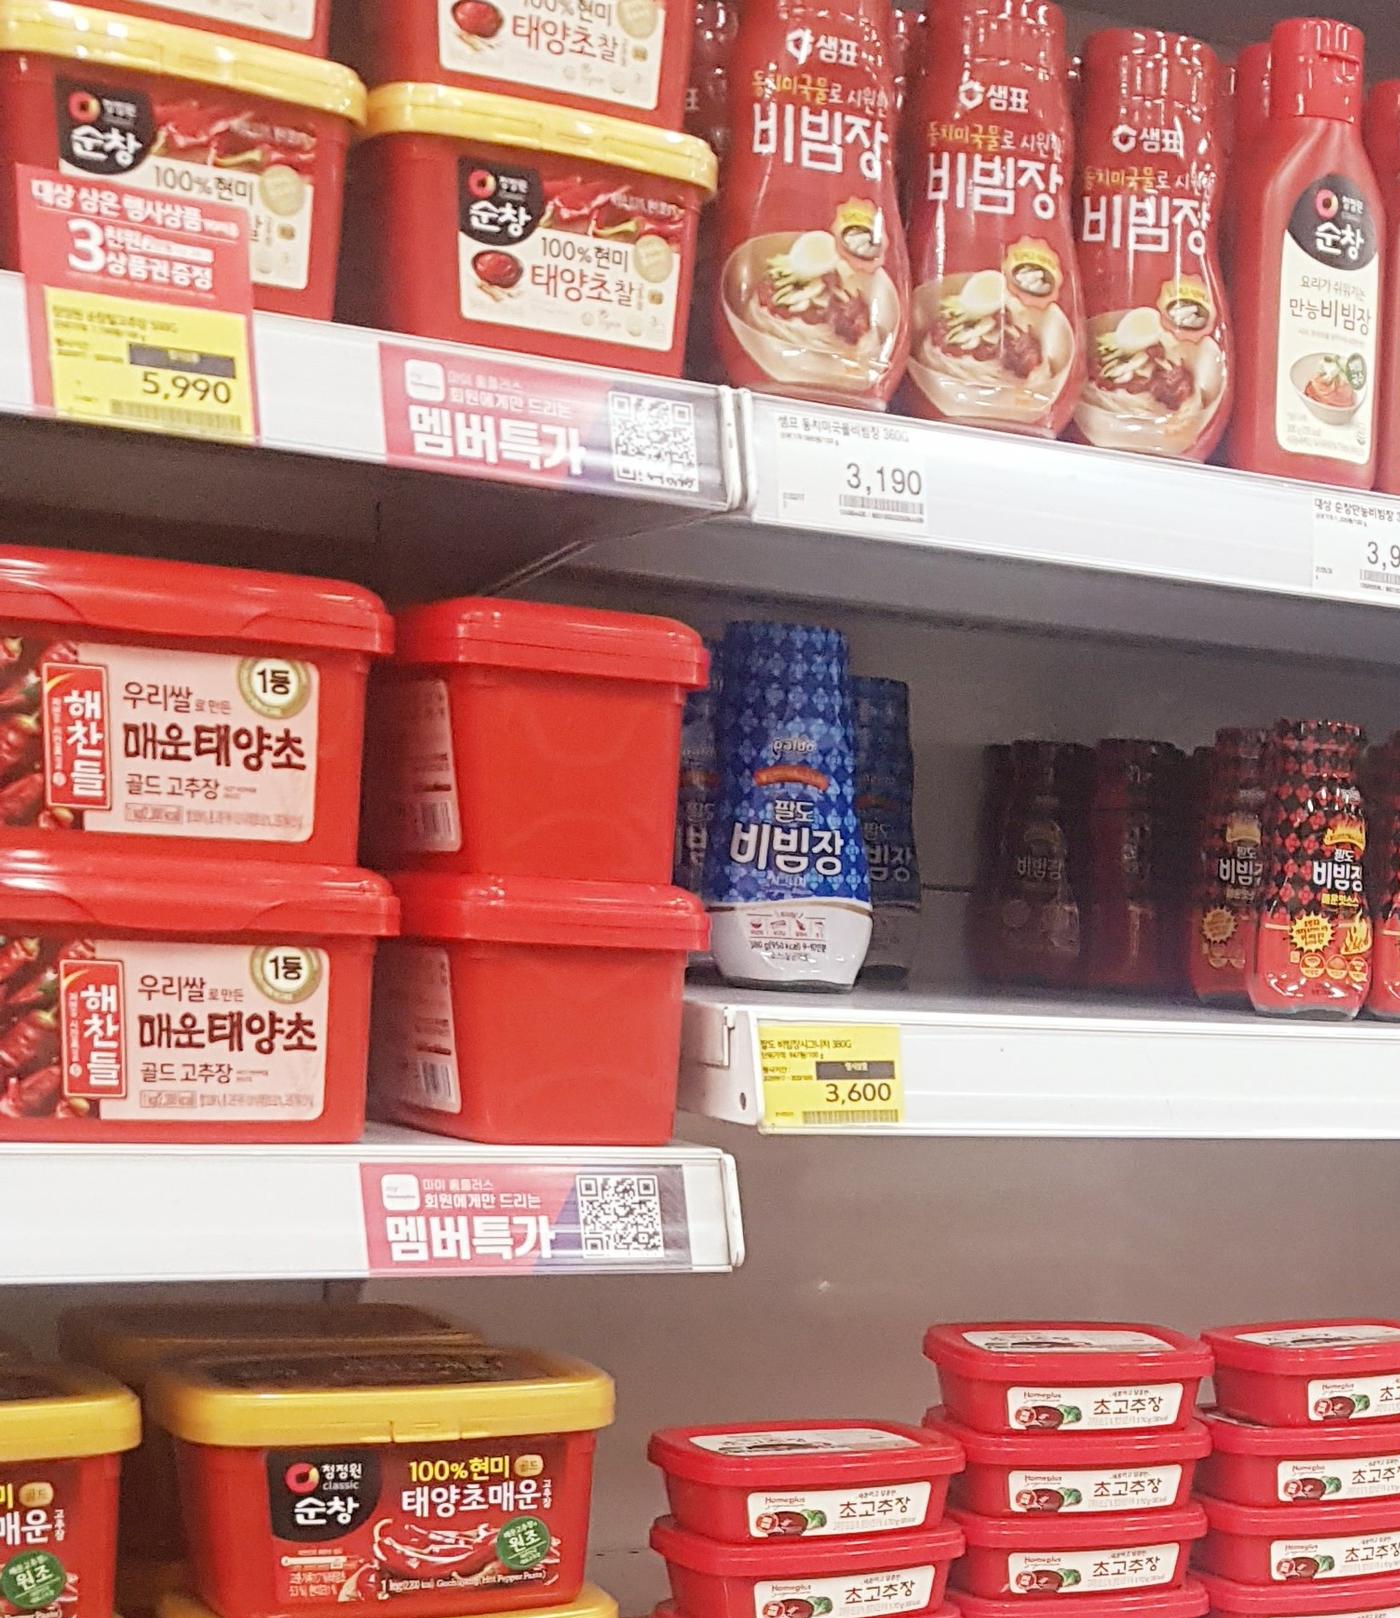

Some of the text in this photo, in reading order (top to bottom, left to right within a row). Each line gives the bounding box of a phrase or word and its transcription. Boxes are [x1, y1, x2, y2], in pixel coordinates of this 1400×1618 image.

[815, 35, 861, 66] 샘표
[986, 84, 1031, 114] 샘표
[1138, 124, 1185, 157] 샘표
[469, 200, 532, 237] 순창
[67, 218, 105, 272] 3
[1288, 296, 1373, 336] 만능비빔장
[142, 370, 232, 404] 5,990
[408, 404, 588, 475] 멤버특가
[846, 462, 922, 496] 3,190
[122, 681, 194, 713] 우리쌀
[256, 669, 292, 695] 1등
[62, 690, 106, 798] 해찬들
[122, 722, 307, 772] 매운태양초
[126, 773, 162, 796] 골드
[774, 799, 815, 823] 팔도
[269, 954, 304, 981] 1등
[138, 974, 206, 1002] 우리쌀
[80, 984, 121, 1086] 해찬들
[138, 1011, 318, 1055] 매운태양초
[140, 1061, 177, 1083] 골드
[825, 1083, 891, 1105] 3,600
[425, 1193, 541, 1209] 회원에게만 드리는
[385, 1215, 556, 1262] 멤버특가
[321, 1462, 363, 1480] 청정원
[322, 1480, 360, 1491] classic
[293, 1496, 360, 1526] 순창
[400, 1479, 542, 1518] 태양초매운
[839, 1493, 913, 1520] 초고추장
[508, 1529, 540, 1553] 원조
